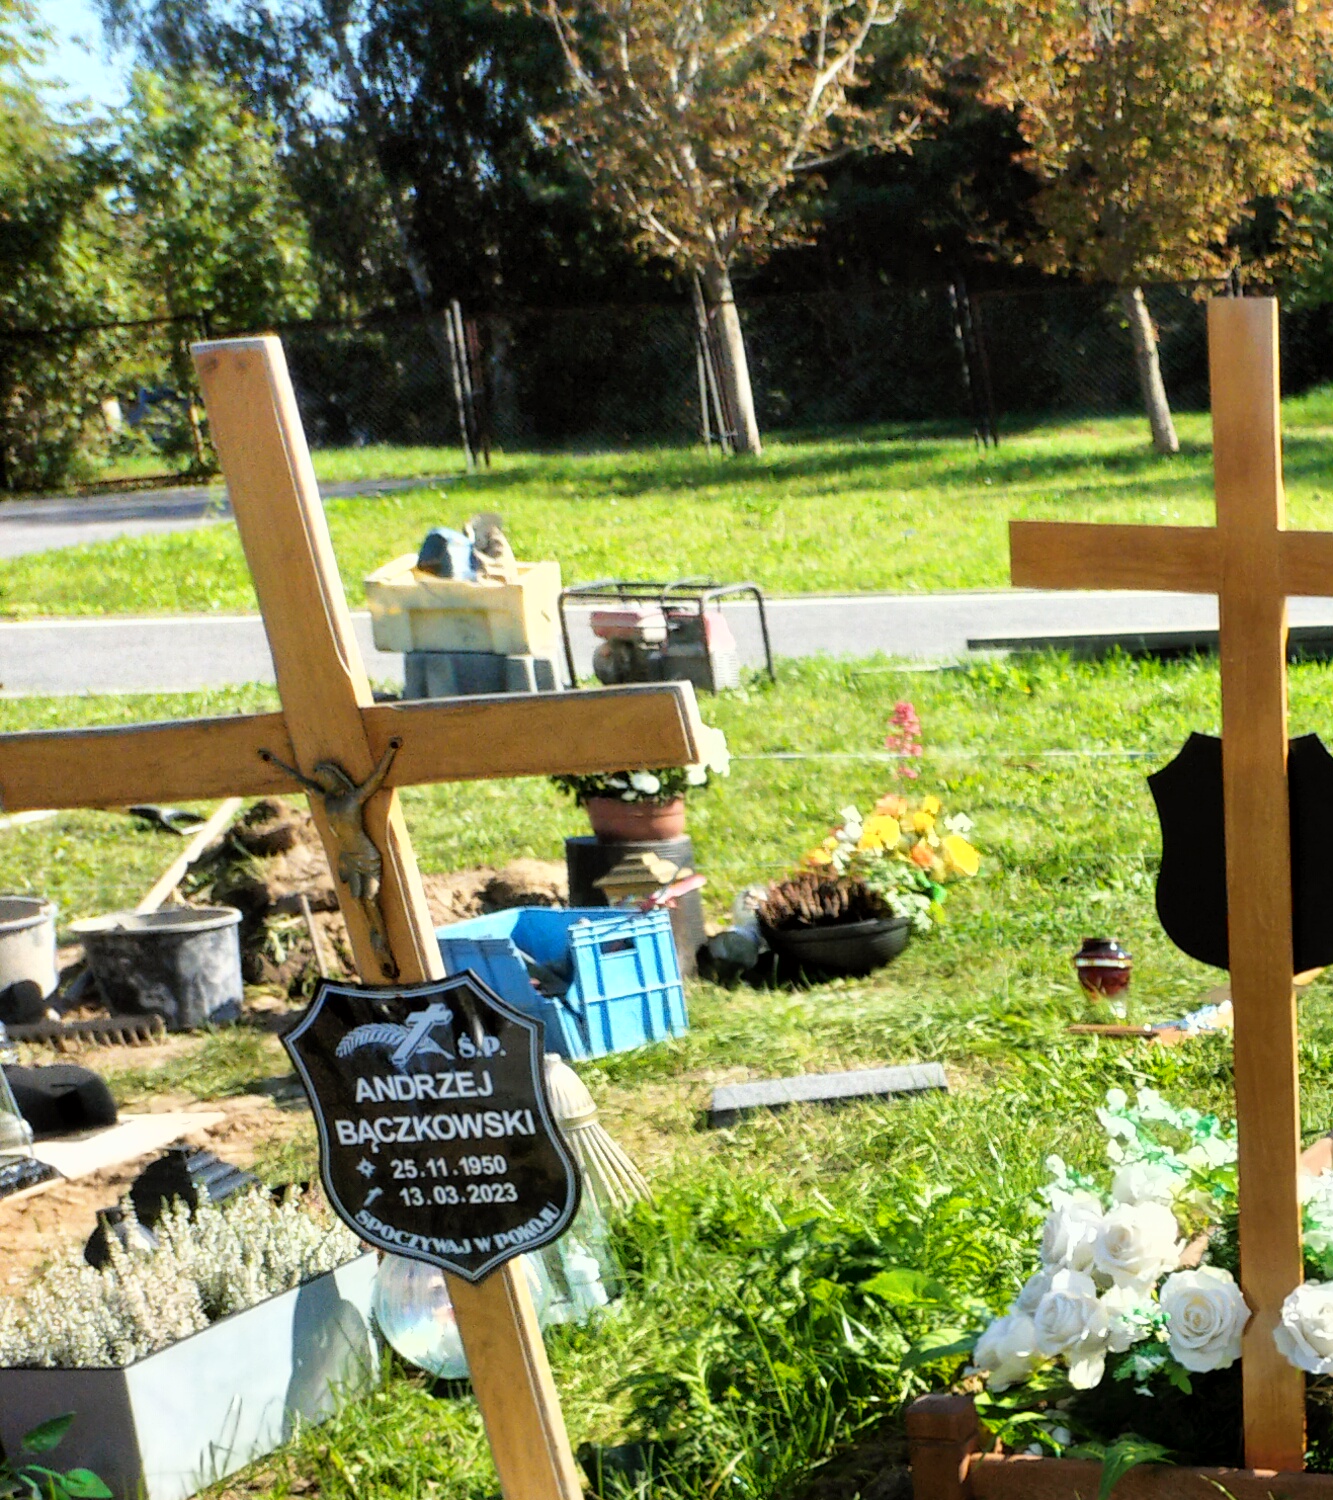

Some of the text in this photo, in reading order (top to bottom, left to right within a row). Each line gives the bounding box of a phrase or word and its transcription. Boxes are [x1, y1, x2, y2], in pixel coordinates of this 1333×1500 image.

[355, 1071, 493, 1103] ANDRZEJ
[335, 1109, 536, 1153] BĄCZKOWSKI
[390, 1155, 507, 1179] 25.11.1950
[399, 1183, 518, 1206] 13.03.2023
[354, 1202, 561, 1255] SPOCZYWAJ W POKOJU
